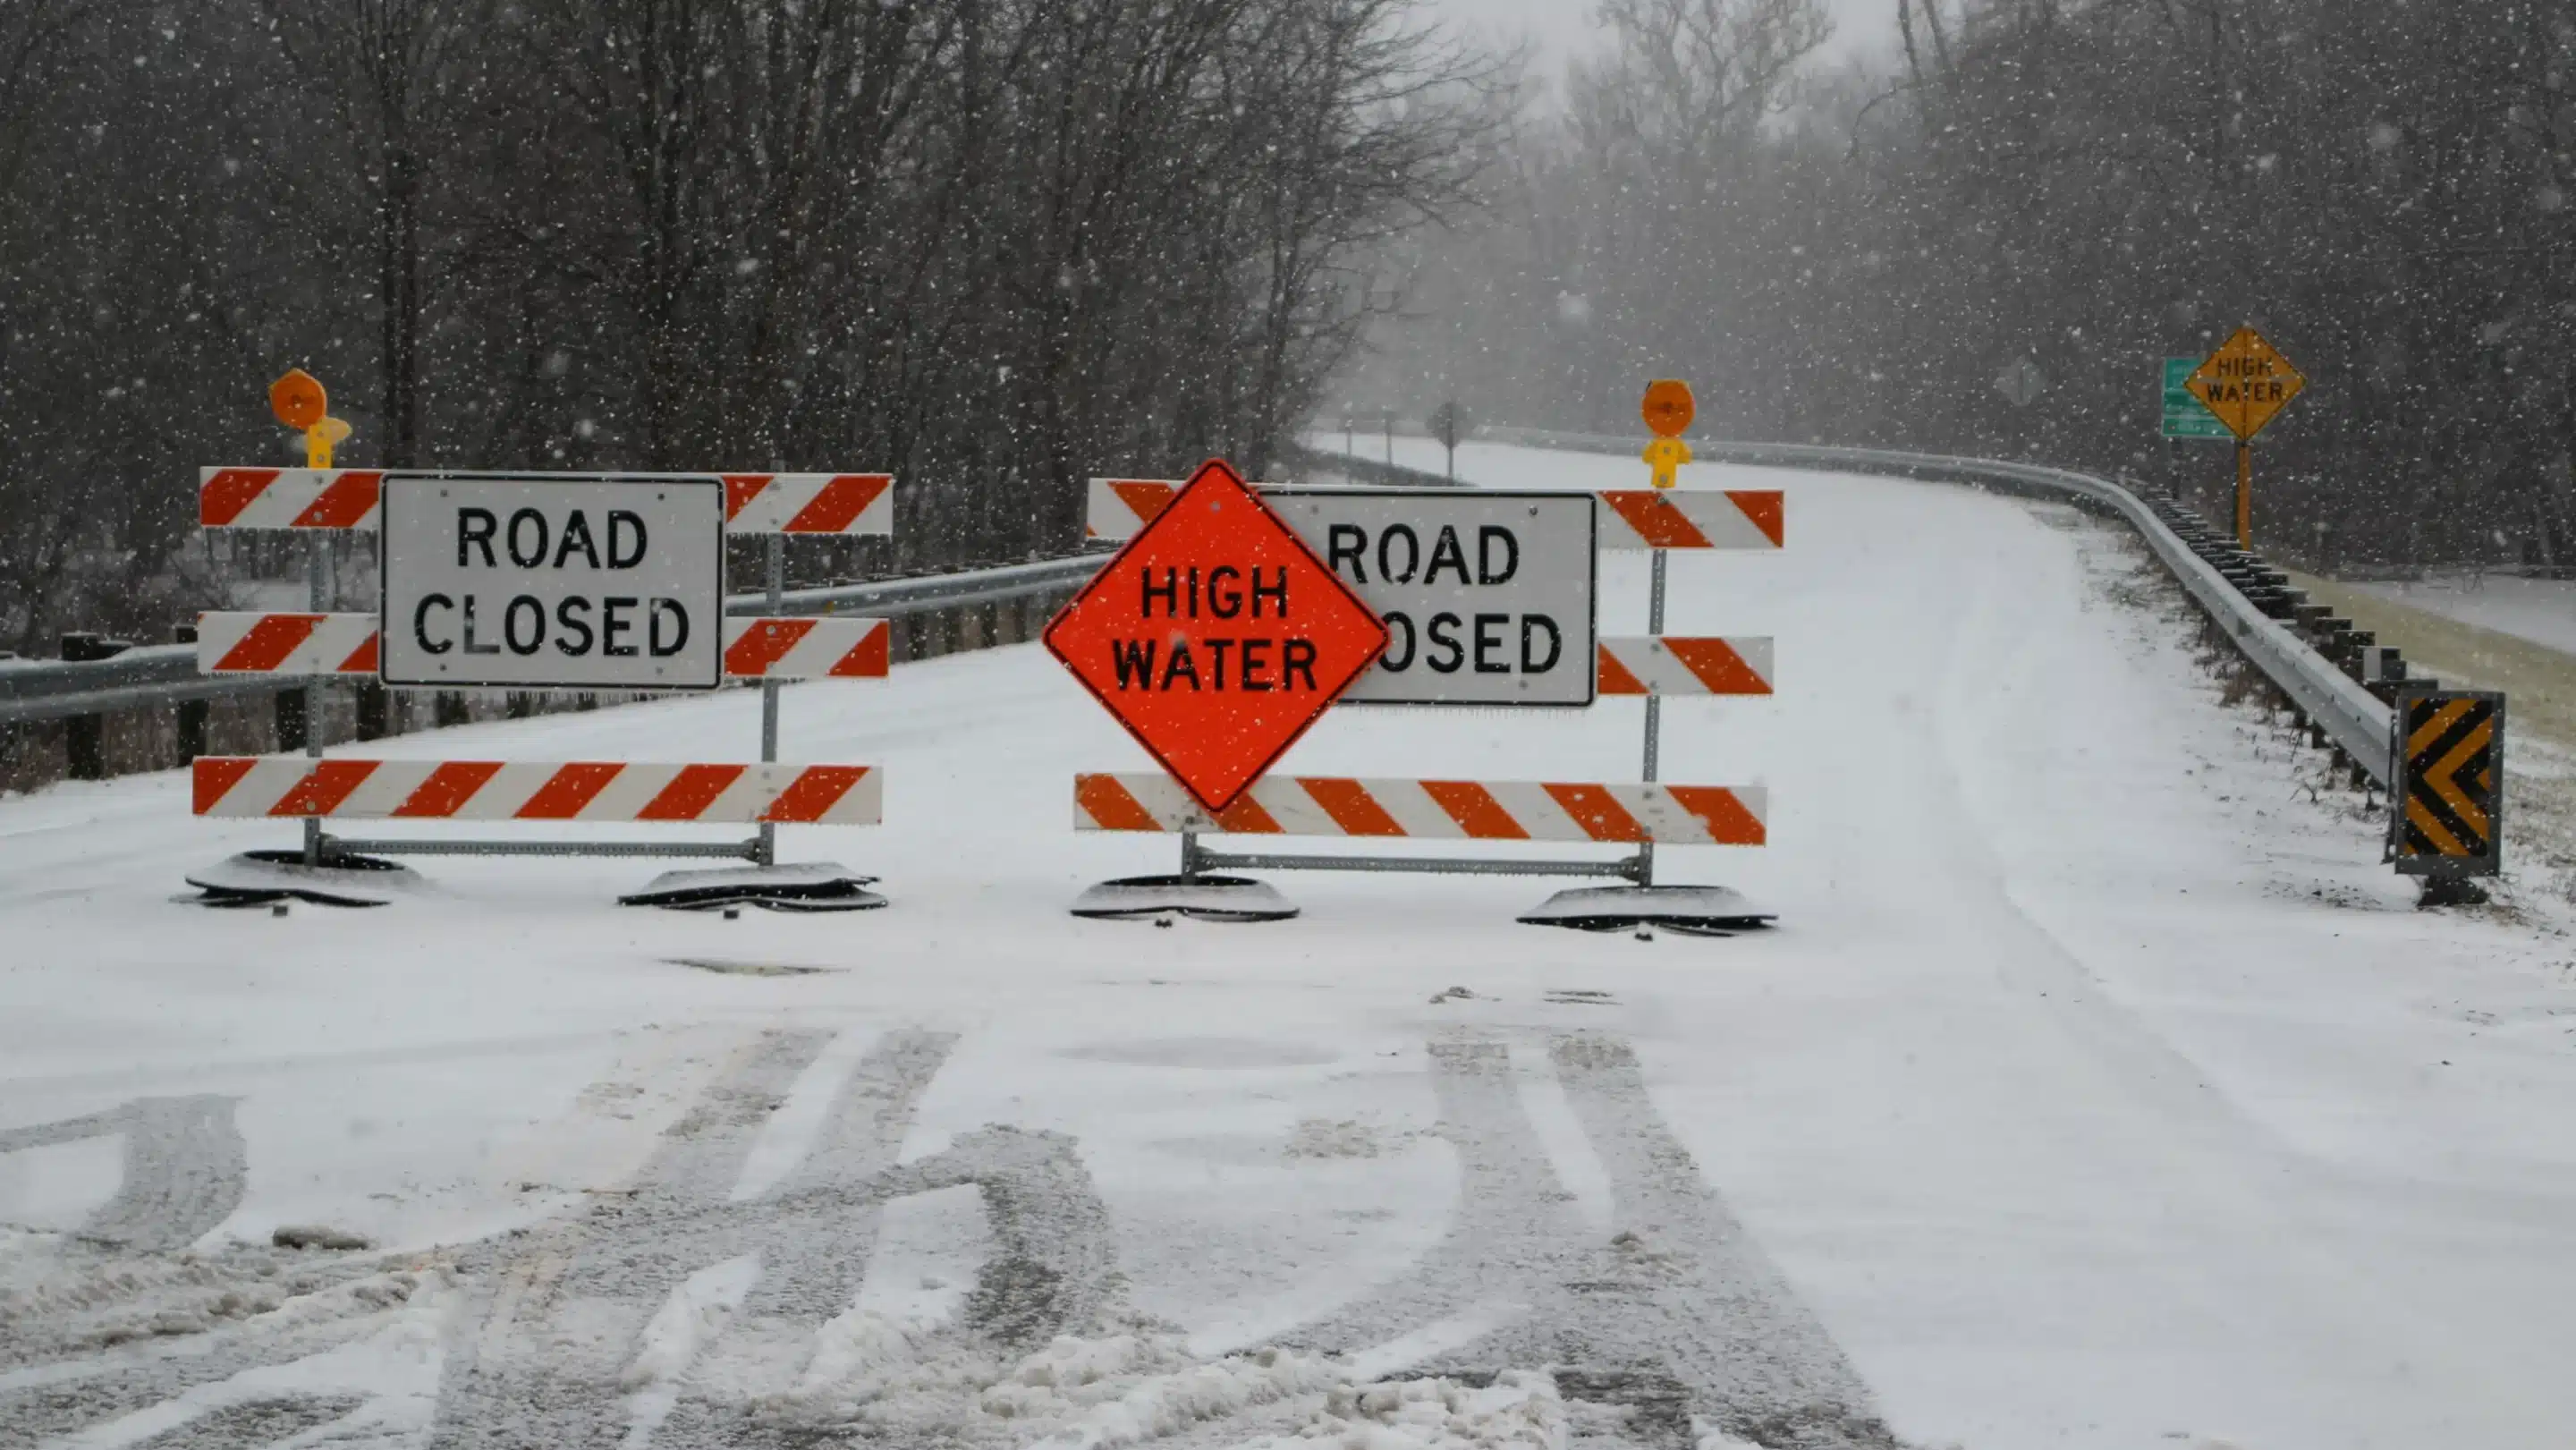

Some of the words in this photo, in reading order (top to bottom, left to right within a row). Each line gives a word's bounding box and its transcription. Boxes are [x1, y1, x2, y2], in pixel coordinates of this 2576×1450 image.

[2207, 383, 2284, 402] WATER
[2216, 358, 2273, 377] HIGH
[457, 507, 648, 570] ROAD
[1328, 523, 1520, 585] ROAD
[1141, 565, 1288, 618] HIGH
[414, 592, 689, 657] CLOSED
[1375, 611, 1562, 673] OSED
[1113, 639, 1318, 691] WATER
